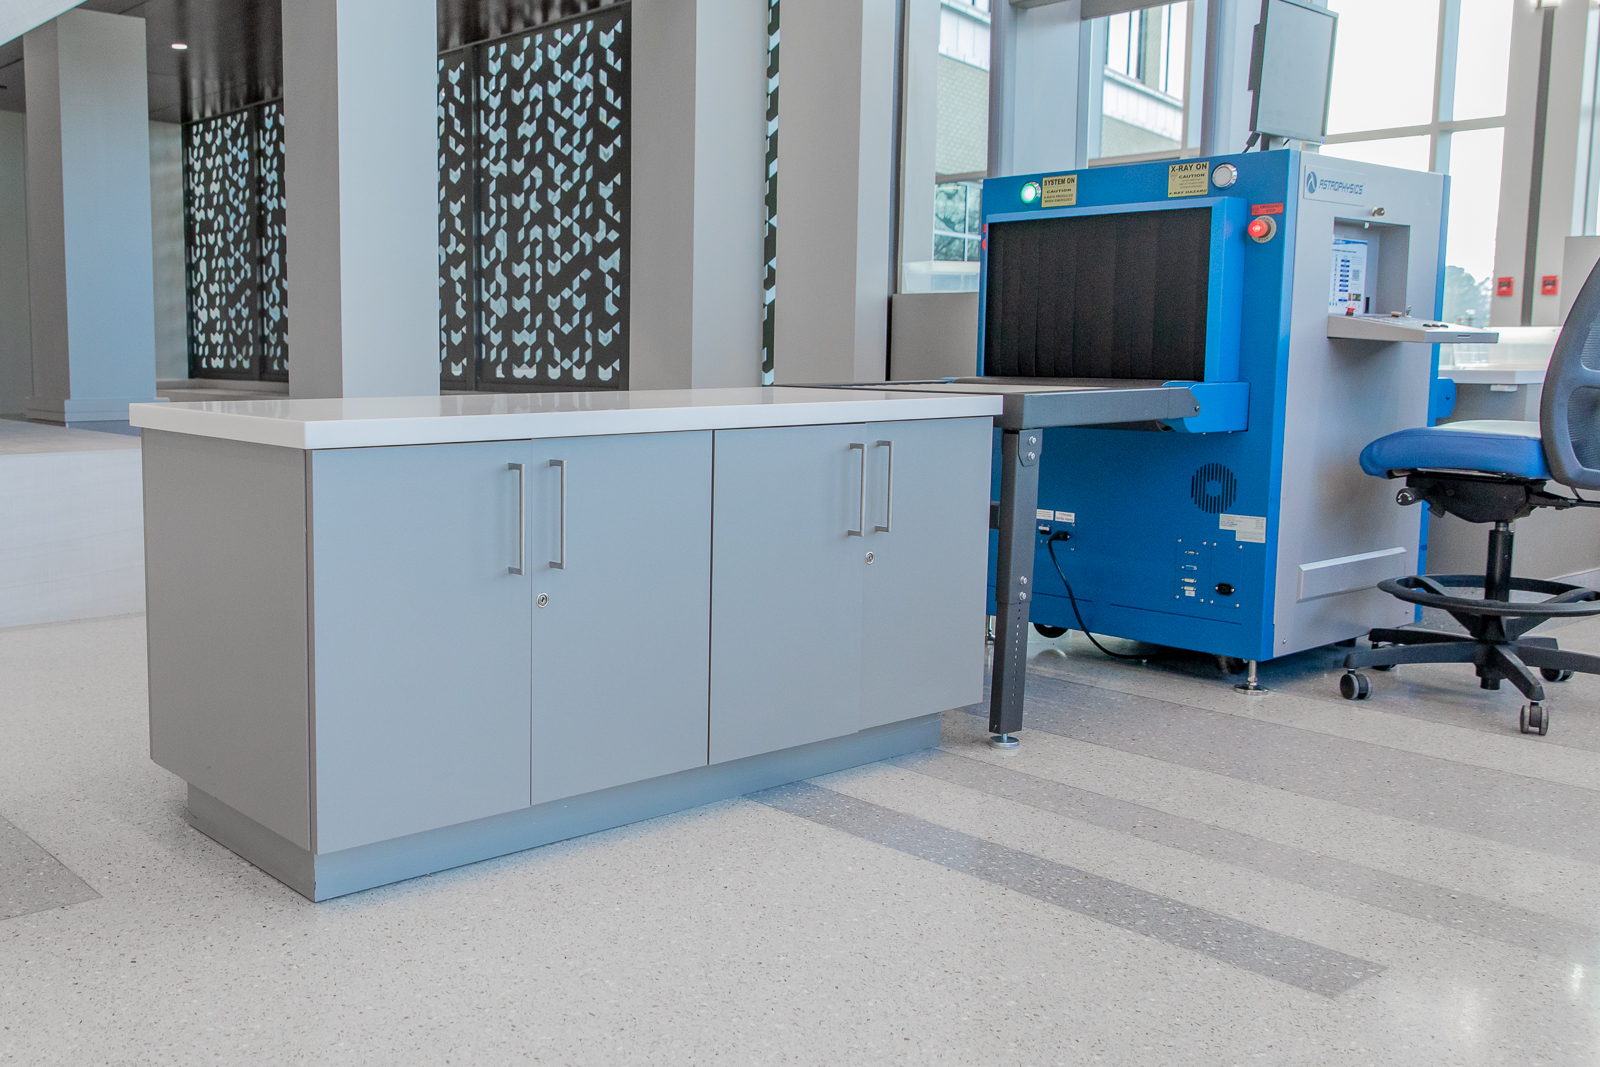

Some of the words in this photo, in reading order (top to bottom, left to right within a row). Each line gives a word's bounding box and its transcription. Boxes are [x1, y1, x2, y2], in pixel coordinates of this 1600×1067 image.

[1171, 163, 1193, 172] X-RAY
[1044, 178, 1066, 186] SYSTEM
[1319, 179, 1363, 195] ASTROPHYSICS
